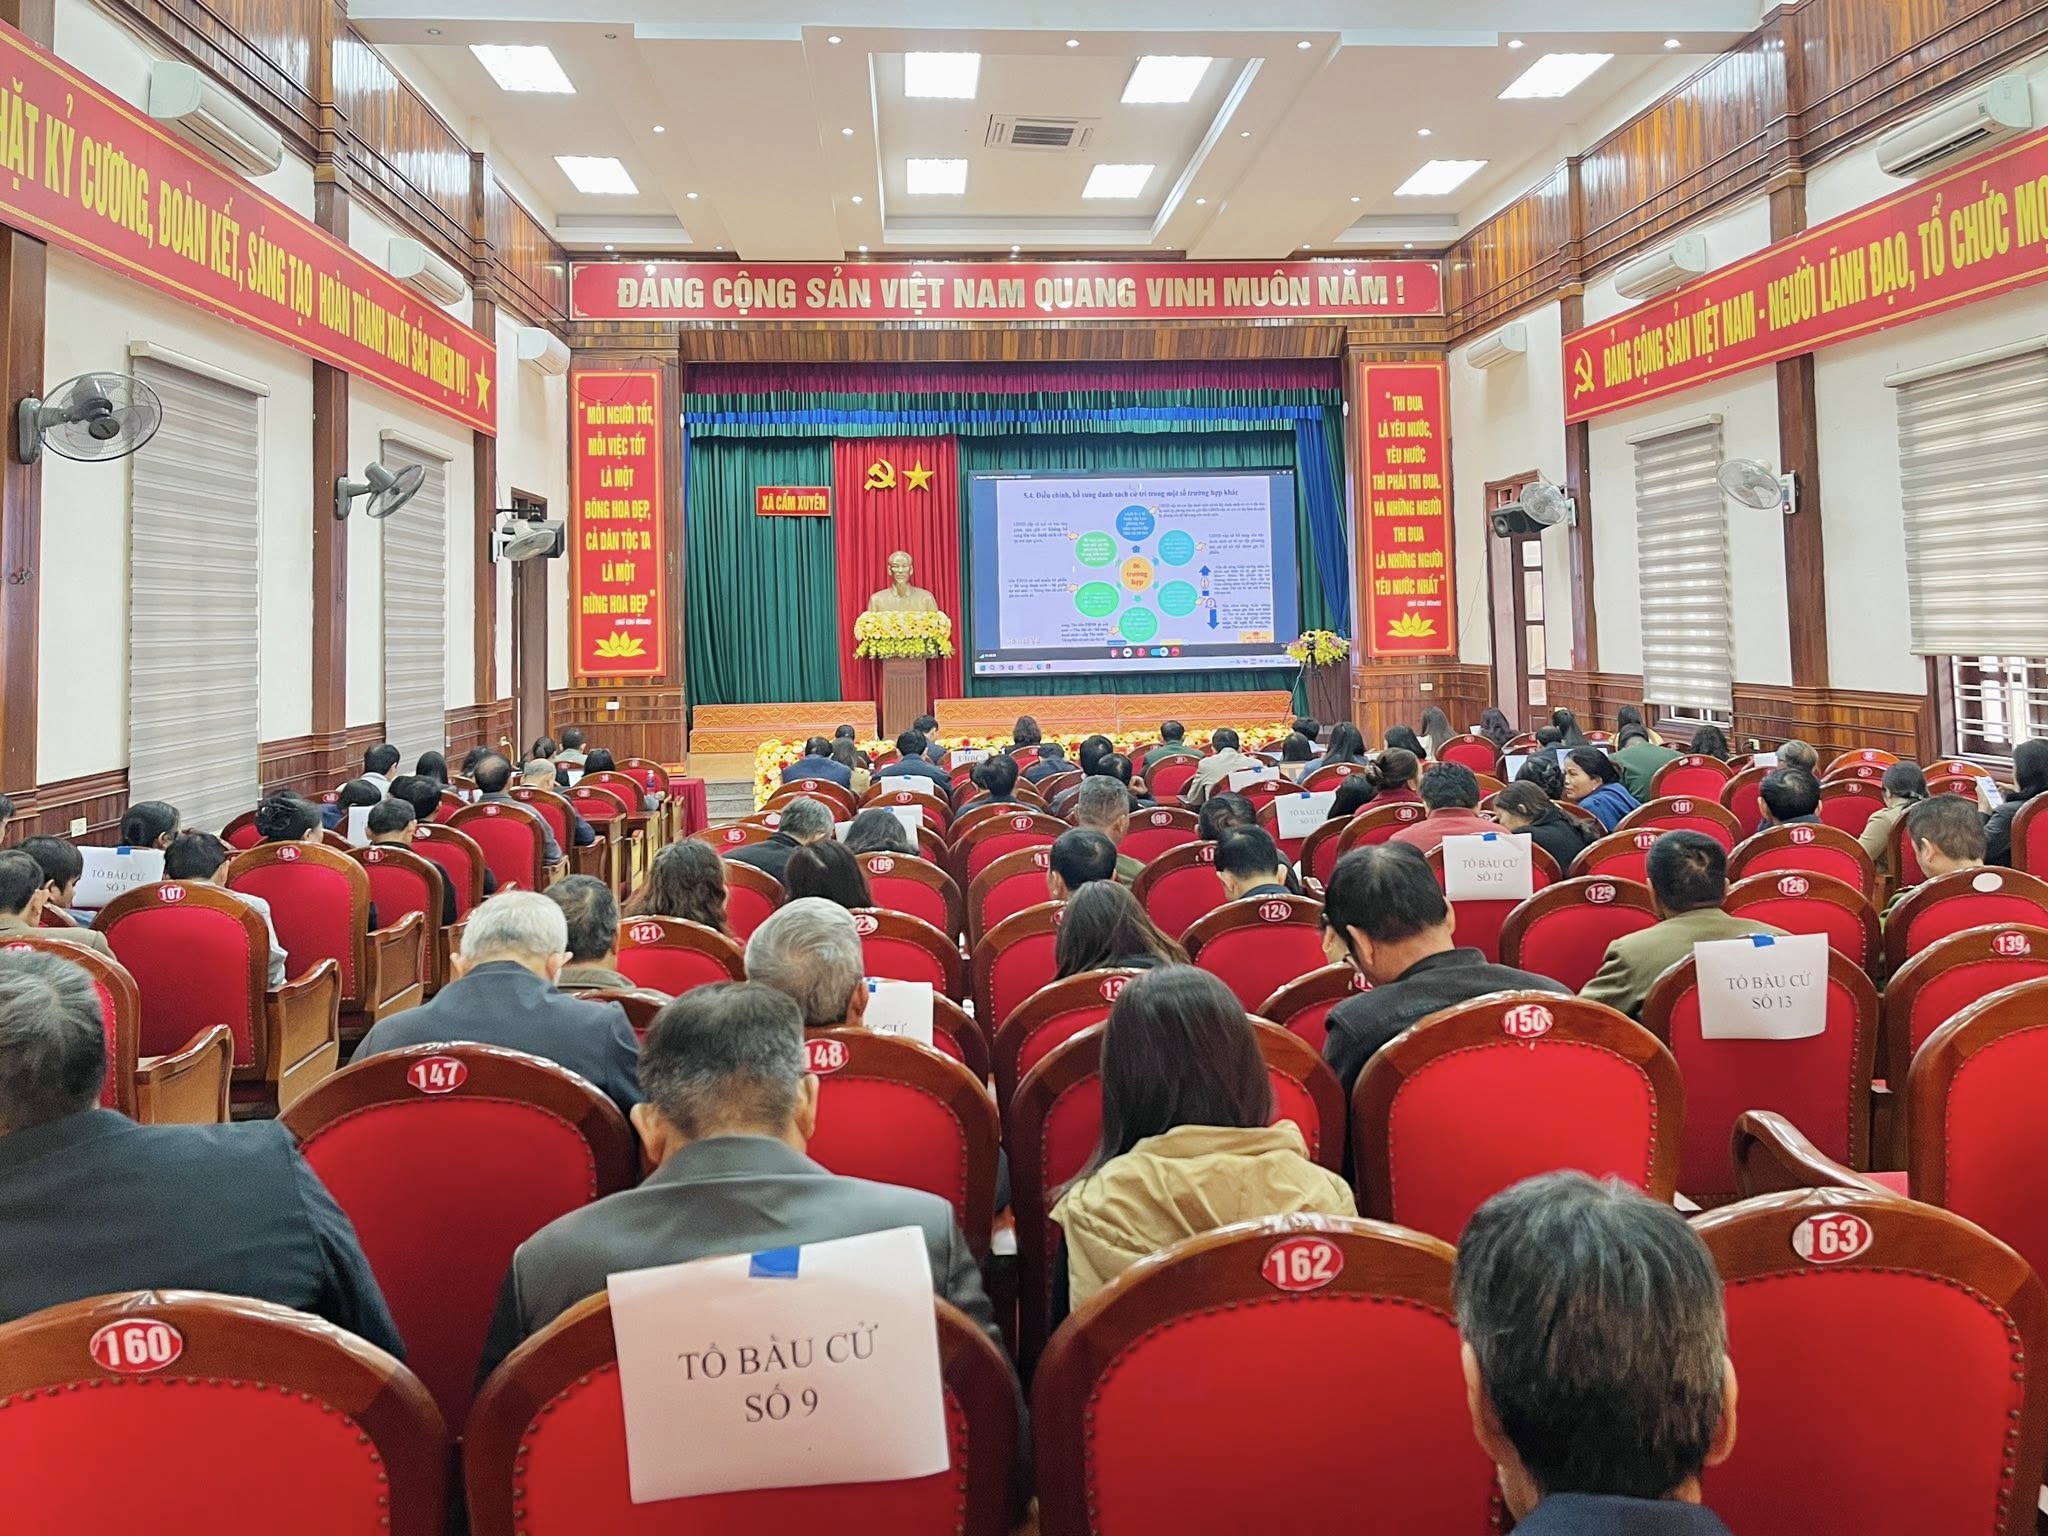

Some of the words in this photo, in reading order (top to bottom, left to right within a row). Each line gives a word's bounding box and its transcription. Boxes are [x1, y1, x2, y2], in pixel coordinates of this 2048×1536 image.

[45, 93, 75, 198] KỶ
[80, 136, 153, 249] CƯƠNG,
[159, 180, 207, 265] ĐOÀN
[211, 197, 243, 292] KẾT,
[248, 226, 286, 305] SÁNG
[289, 254, 313, 326] TẠO
[319, 270, 350, 337] HOÀN
[353, 288, 385, 355] THÀNH
[617, 265, 705, 309] ĐẢNG
[712, 270, 797, 315] CỘNG
[806, 266, 871, 309] SẢN
[879, 270, 945, 316] VIỆT
[953, 277, 1026, 309] NAM
[1034, 276, 1137, 312] QUANG
[1146, 276, 1215, 308] VINH
[1223, 269, 1310, 307] MUÔN
[1318, 268, 1387, 306] NĂM
[1633, 325, 1665, 385] CỘNG
[1666, 301, 1691, 367] SẢN
[1692, 298, 1720, 364] VIỆT
[1722, 290, 1757, 347] NAM
[1767, 255, 1818, 332] NGƯỜI
[1819, 247, 1867, 314] LÃNH
[1869, 231, 1916, 305] ĐẠO,
[1918, 192, 1946, 280] TỔ
[1950, 180, 2010, 269] CHỨC
[588, 431, 606, 456] MỖI
[607, 433, 628, 460] VIỆC
[629, 431, 646, 456] TỐT
[601, 465, 613, 487] LÀ
[614, 465, 634, 491] MỘT
[584, 497, 610, 519] BÔNG
[611, 499, 630, 519] HOA
[762, 493, 775, 511] XÃ
[797, 492, 826, 511] XUYÊN
[585, 526, 599, 551] CẢ
[600, 527, 620, 551] DÂN
[621, 528, 639, 554] TỘC
[640, 531, 651, 551] TA
[602, 560, 614, 582] LÀ
[615, 559, 636, 586] MỘT
[1400, 808, 1412, 819] 99
[1674, 801, 1690, 812] 101
[1016, 819, 1028, 828] 97
[1793, 829, 1811, 841] 114
[282, 846, 295, 857] 94
[872, 858, 891, 871] 109
[1493, 873, 1504, 881] 12
[1781, 879, 1805, 893] 126
[160, 886, 181, 900] 107
[1591, 886, 1615, 900] 125
[1263, 904, 1287, 919] 124
[1998, 935, 2024, 952] 139
[1727, 973, 1748, 990] TỔ
[1752, 973, 1785, 989] BẦU
[1789, 970, 1811, 987] CỬ
[1752, 993, 1773, 1009] SỐ
[1779, 995, 1793, 1009] 13
[1507, 1008, 1547, 1034] 150
[803, 1042, 843, 1069] 148
[415, 1060, 459, 1089] 147
[1806, 1219, 1858, 1256] 163
[1272, 1247, 1334, 1282] 162
[104, 1327, 168, 1366] 160
[678, 1341, 727, 1380] TỔ
[738, 1334, 814, 1376] BẦU
[826, 1321, 880, 1364] CỬ
[744, 1383, 791, 1423] SỐ
[801, 1388, 819, 1417] 9
